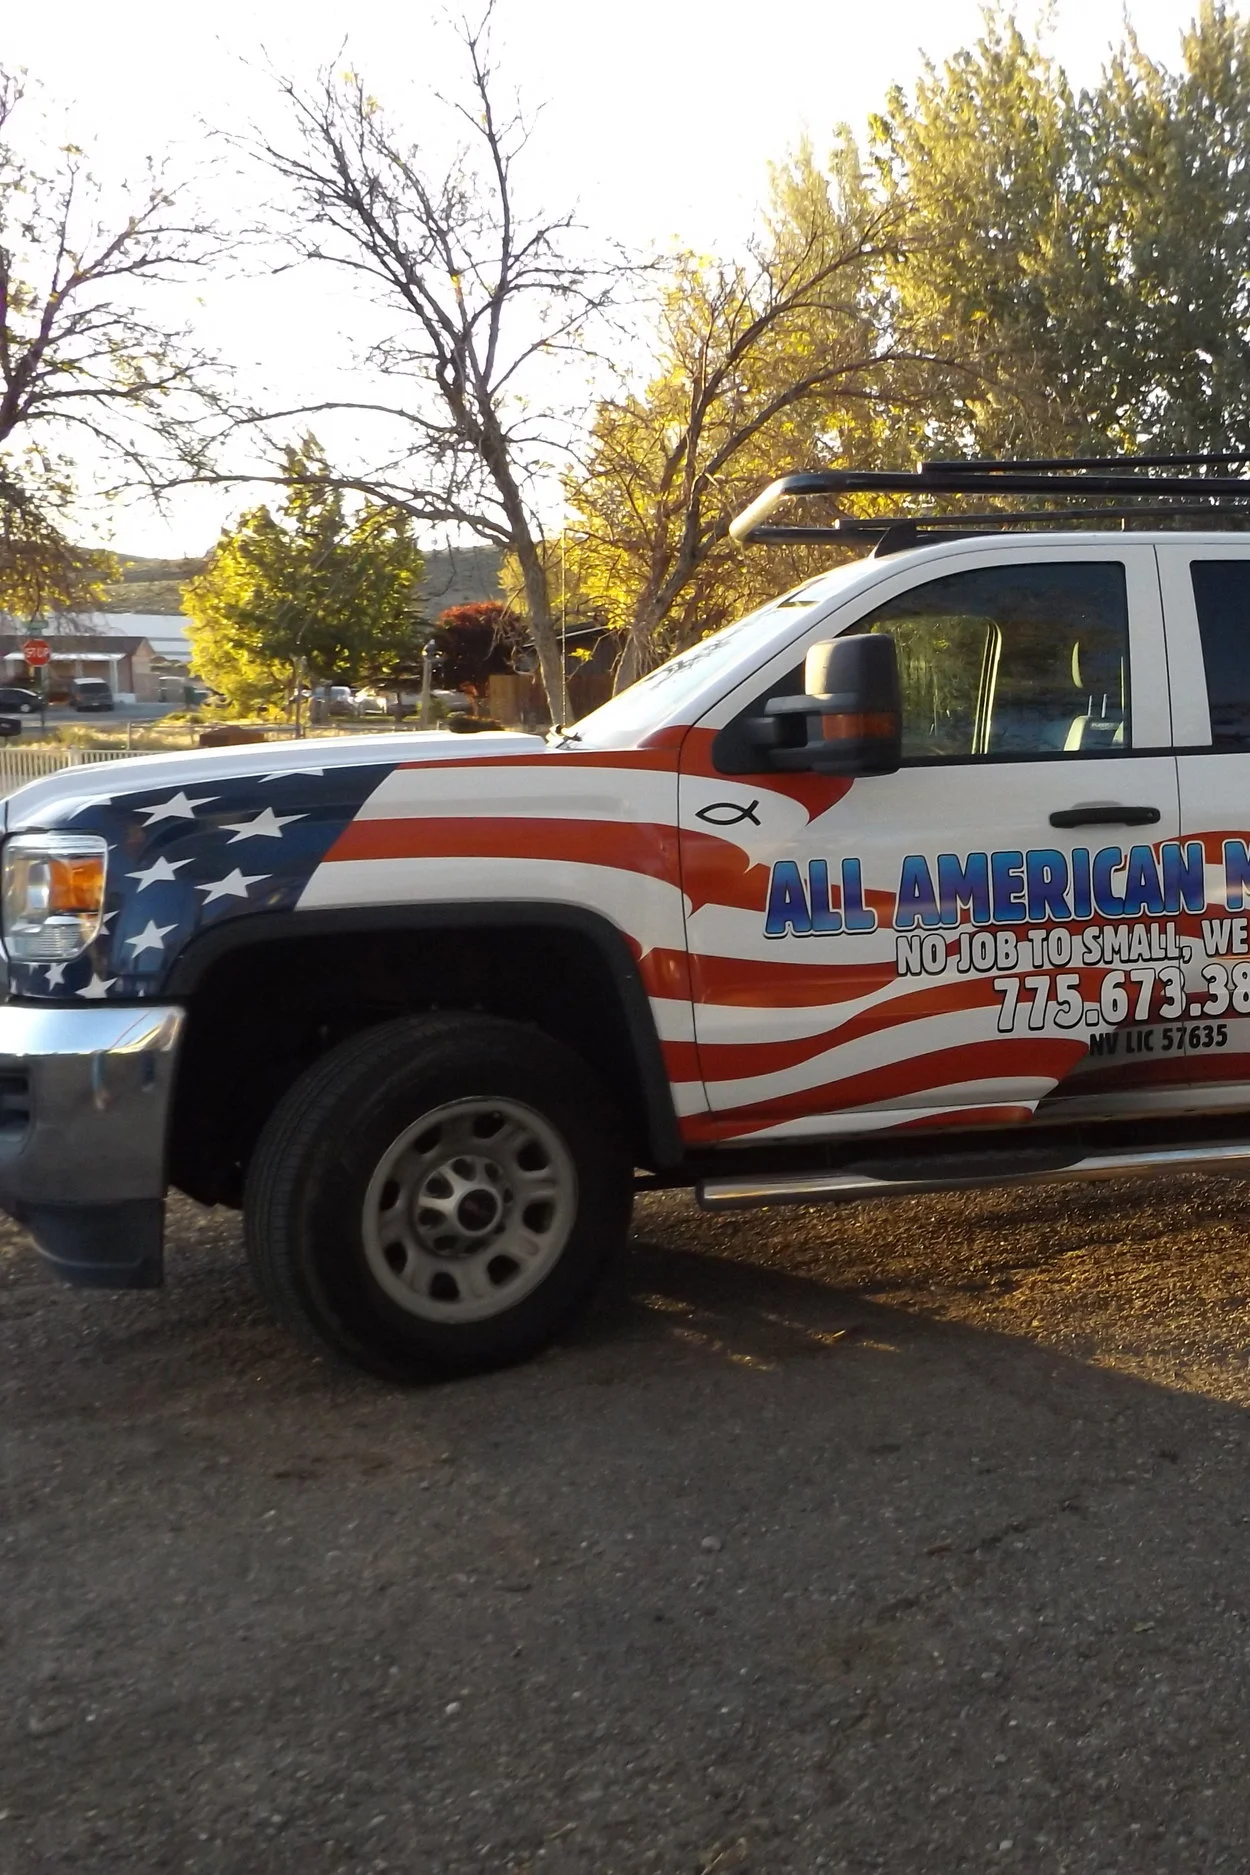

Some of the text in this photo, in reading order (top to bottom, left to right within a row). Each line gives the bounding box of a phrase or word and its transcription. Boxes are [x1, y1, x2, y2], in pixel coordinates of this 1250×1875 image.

[764, 857, 877, 937] ALL
[894, 840, 1206, 930] AMERICAN
[897, 934, 947, 976] NO
[957, 931, 1018, 973] JOB
[1027, 927, 1073, 969] TO
[1082, 921, 1193, 965] SMALL,
[1201, 917, 1249, 956] WE
[1089, 1024, 1228, 1056] NV LIC 57635
